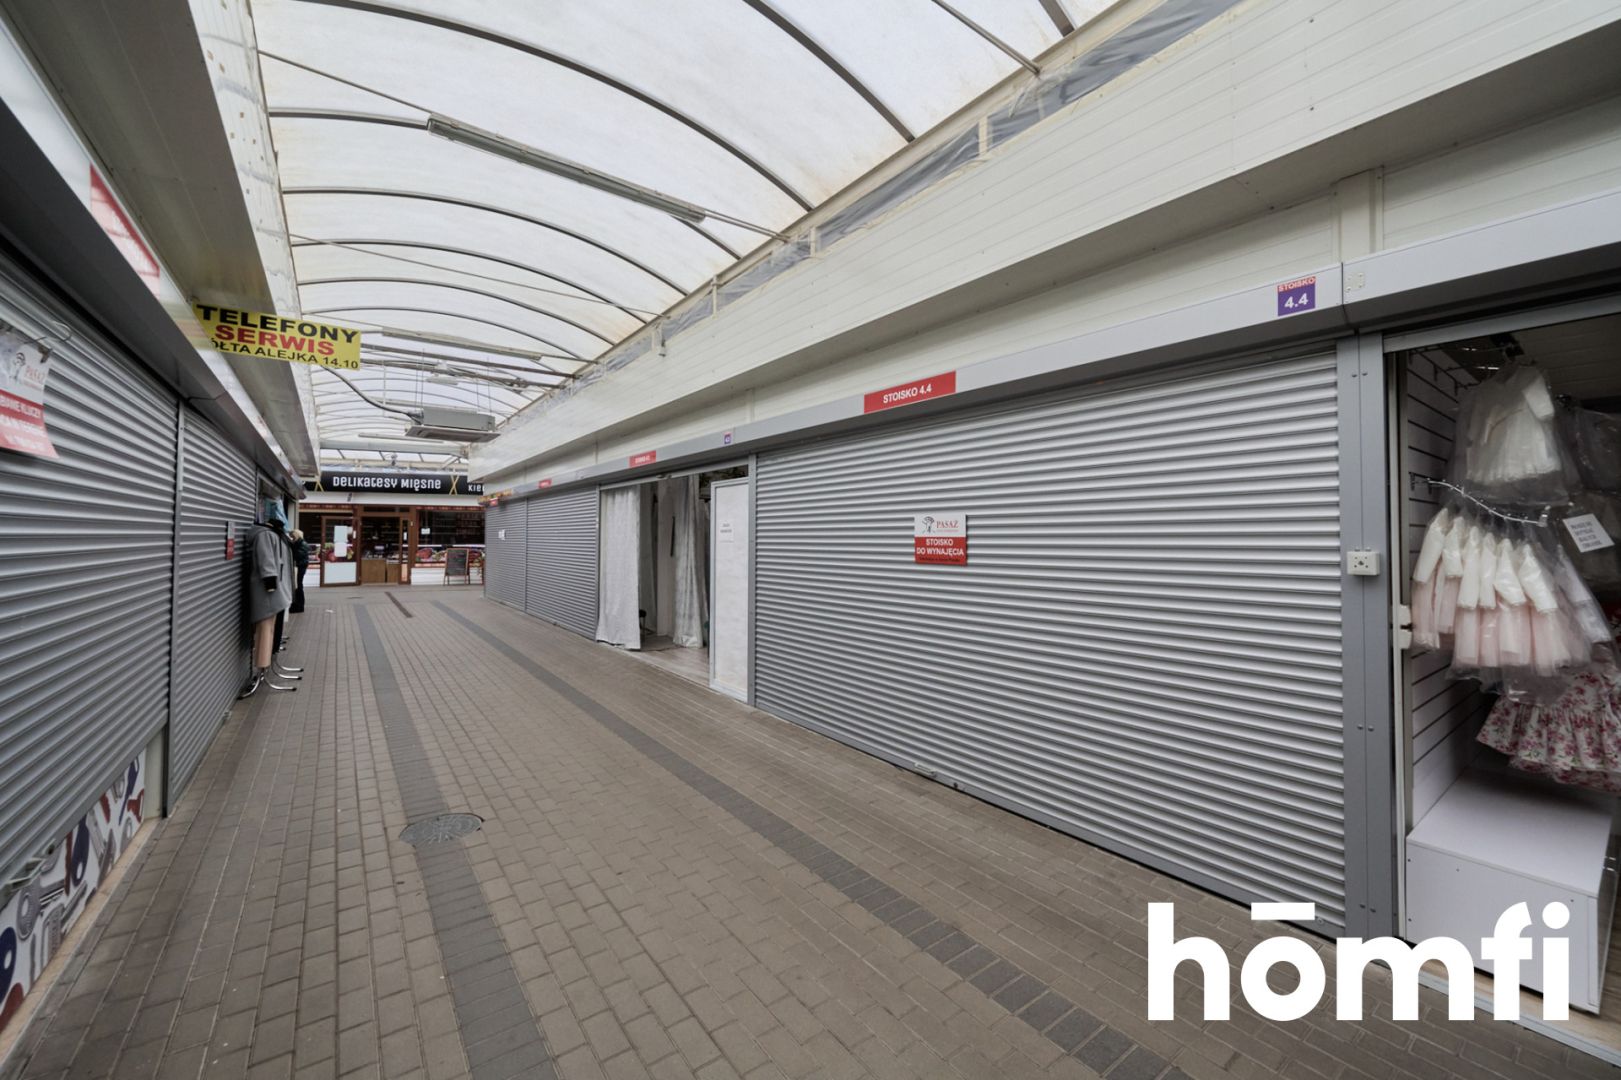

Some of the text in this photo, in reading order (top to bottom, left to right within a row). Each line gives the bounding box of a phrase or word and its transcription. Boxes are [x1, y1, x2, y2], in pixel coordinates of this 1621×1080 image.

[1278, 276, 1316, 292] STOISKO
[1284, 293, 1309, 309] 4.4
[196, 304, 358, 344] TELEFONY
[215, 324, 335, 356] SERWIS
[255, 347, 318, 364] ALEJKA
[323, 356, 359, 370] 14.10
[883, 383, 933, 404] STOISKO 4.4
[926, 538, 954, 546] STOISKO
[916, 547, 965, 557] DO WYNAJĘCIA
